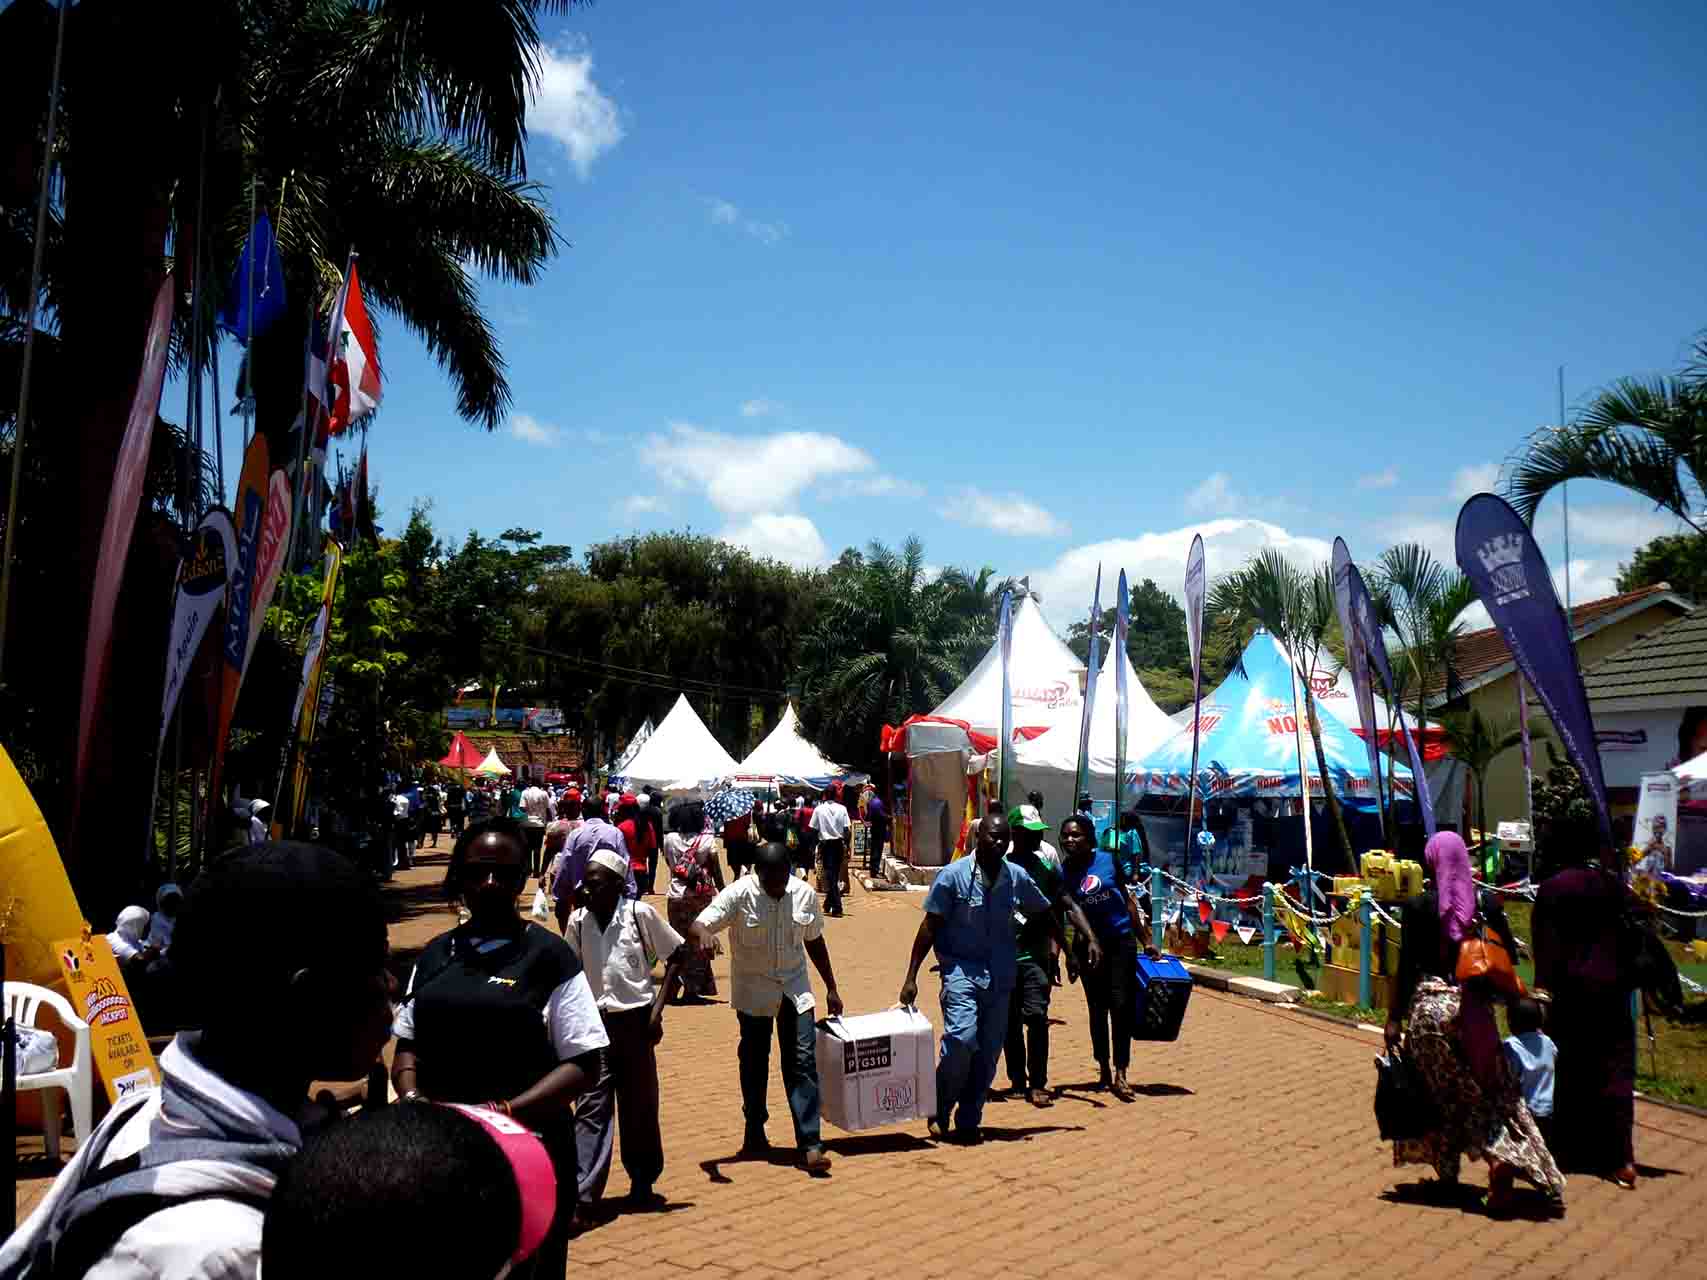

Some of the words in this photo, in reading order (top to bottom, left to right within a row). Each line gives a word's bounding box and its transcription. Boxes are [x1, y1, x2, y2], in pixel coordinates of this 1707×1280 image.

[106, 1032, 133, 1046] TICKETS
[108, 1043, 140, 1059] AVAILABLE
[848, 1055, 888, 1071] PG310
